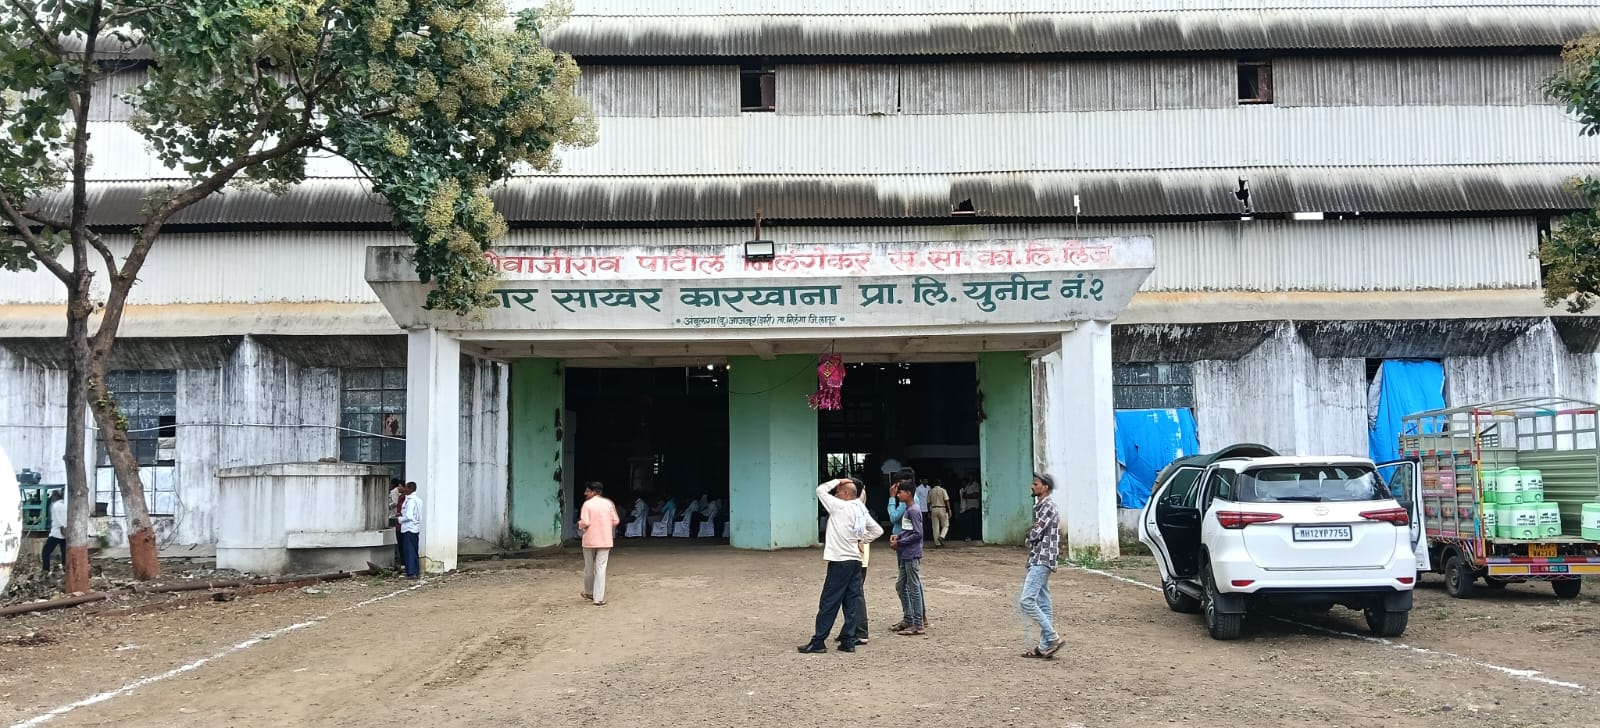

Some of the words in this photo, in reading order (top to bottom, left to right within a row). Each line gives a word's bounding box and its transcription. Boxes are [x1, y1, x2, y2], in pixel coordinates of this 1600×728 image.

[637, 248, 725, 275] पाटील
[492, 287, 539, 312] ार
[551, 286, 663, 313] साखर
[680, 284, 842, 313] कारखाना
[858, 282, 903, 307] प्रा.
[912, 275, 958, 306] लि.
[962, 272, 1052, 313] युनीट
[1299, 528, 1349, 539] MH12YP7755
